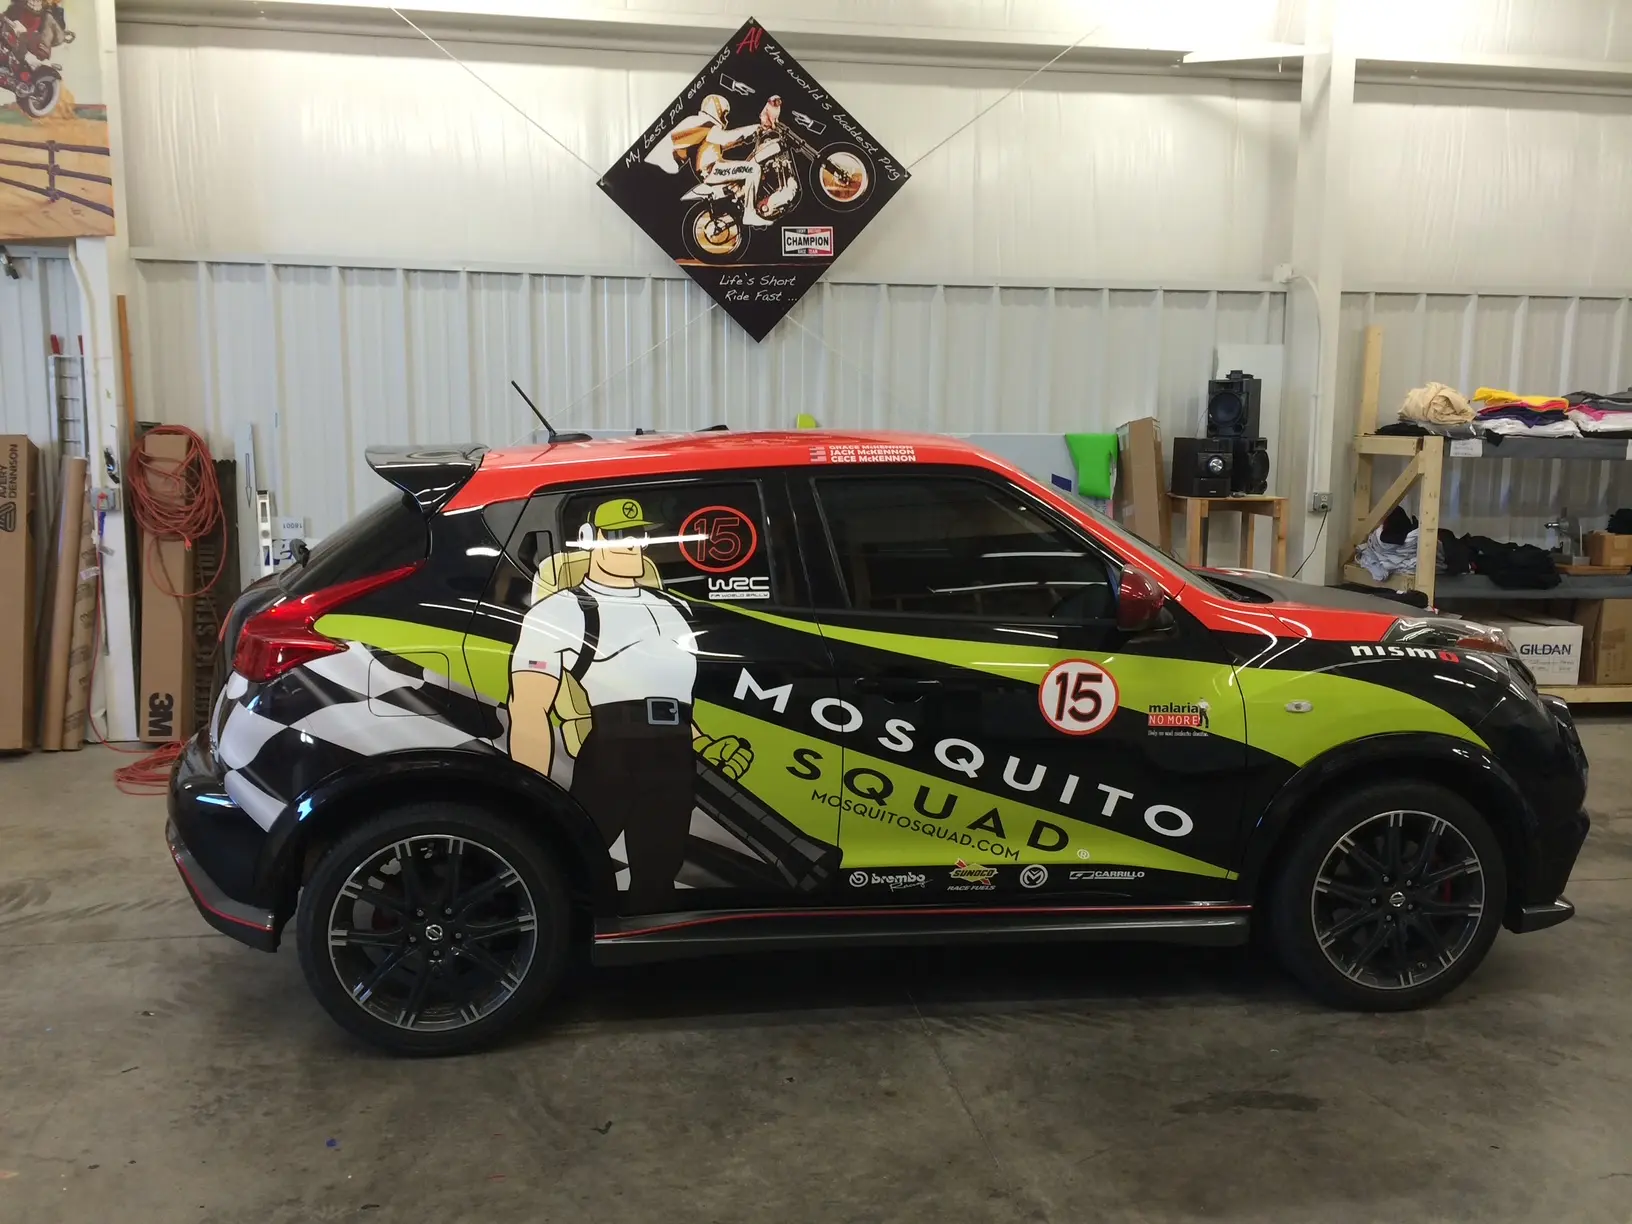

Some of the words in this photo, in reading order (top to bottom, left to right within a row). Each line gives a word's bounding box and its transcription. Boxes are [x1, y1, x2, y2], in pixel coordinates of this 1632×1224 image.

[736, 27, 763, 54] Al
[625, 148, 641, 168] My
[644, 118, 667, 148] best
[669, 96, 684, 125] pal
[687, 75, 706, 99] ever
[710, 46, 731, 73] was
[764, 44, 785, 66] the
[833, 114, 879, 155] baddest
[878, 157, 901, 181] pug
[786, 236, 829, 246] CHAMPION
[719, 272, 756, 286] Life's
[760, 275, 797, 287] Short
[725, 289, 750, 302] Ride
[755, 289, 783, 302] Fast
[858, 455, 917, 463] McKENNON
[8, 444, 18, 499] DENNISON
[694, 517, 741, 562] 15
[708, 577, 770, 591] WRC
[1351, 645, 1460, 664] nismo
[1520, 643, 1572, 656] GILDAN
[1055, 671, 1103, 723] 15
[148, 692, 174, 737] 3M
[1148, 702, 1199, 713] malaria
[1148, 714, 1164, 725] NO
[1167, 714, 1199, 725] MORE
[733, 667, 1194, 837] MOSQUITO
[786, 748, 1069, 852] SQUAD
[811, 789, 1020, 861] MOSQUITOSQUAD.COM
[871, 871, 926, 885] brembo
[953, 869, 996, 877] SUNOCO
[1094, 870, 1145, 879] CARRILLO
